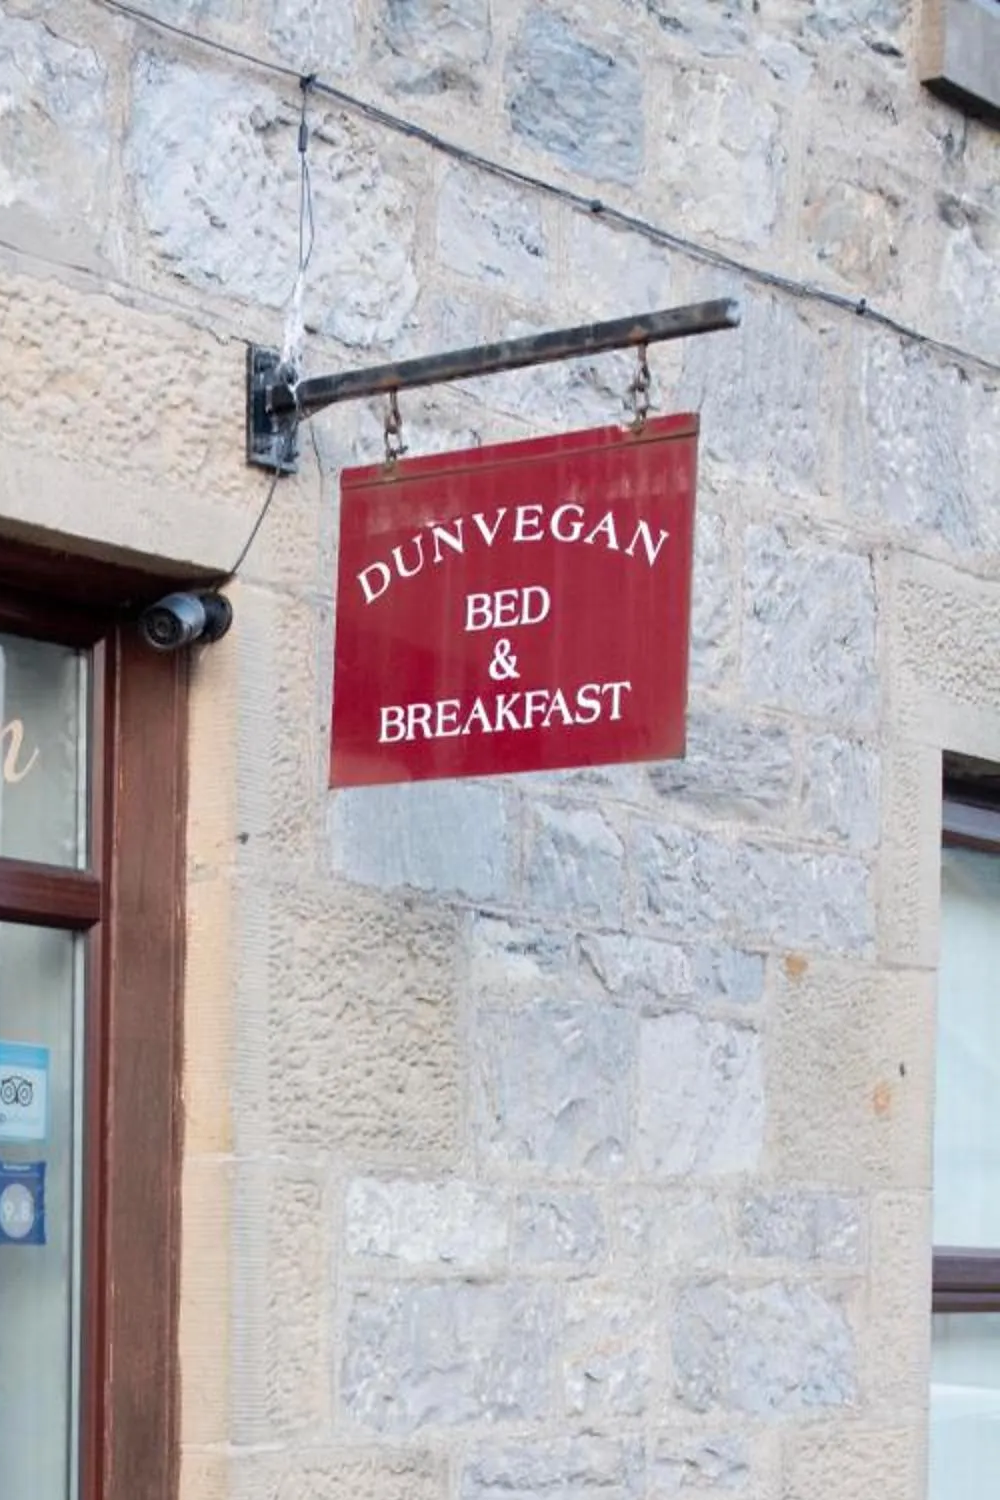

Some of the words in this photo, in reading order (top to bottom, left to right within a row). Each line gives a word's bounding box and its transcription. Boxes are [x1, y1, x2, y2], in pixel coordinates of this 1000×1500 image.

[356, 503, 669, 604] DUNVEGAN
[465, 585, 551, 632] BED
[488, 638, 520, 681] &
[378, 681, 631, 743] BREAKFAST
